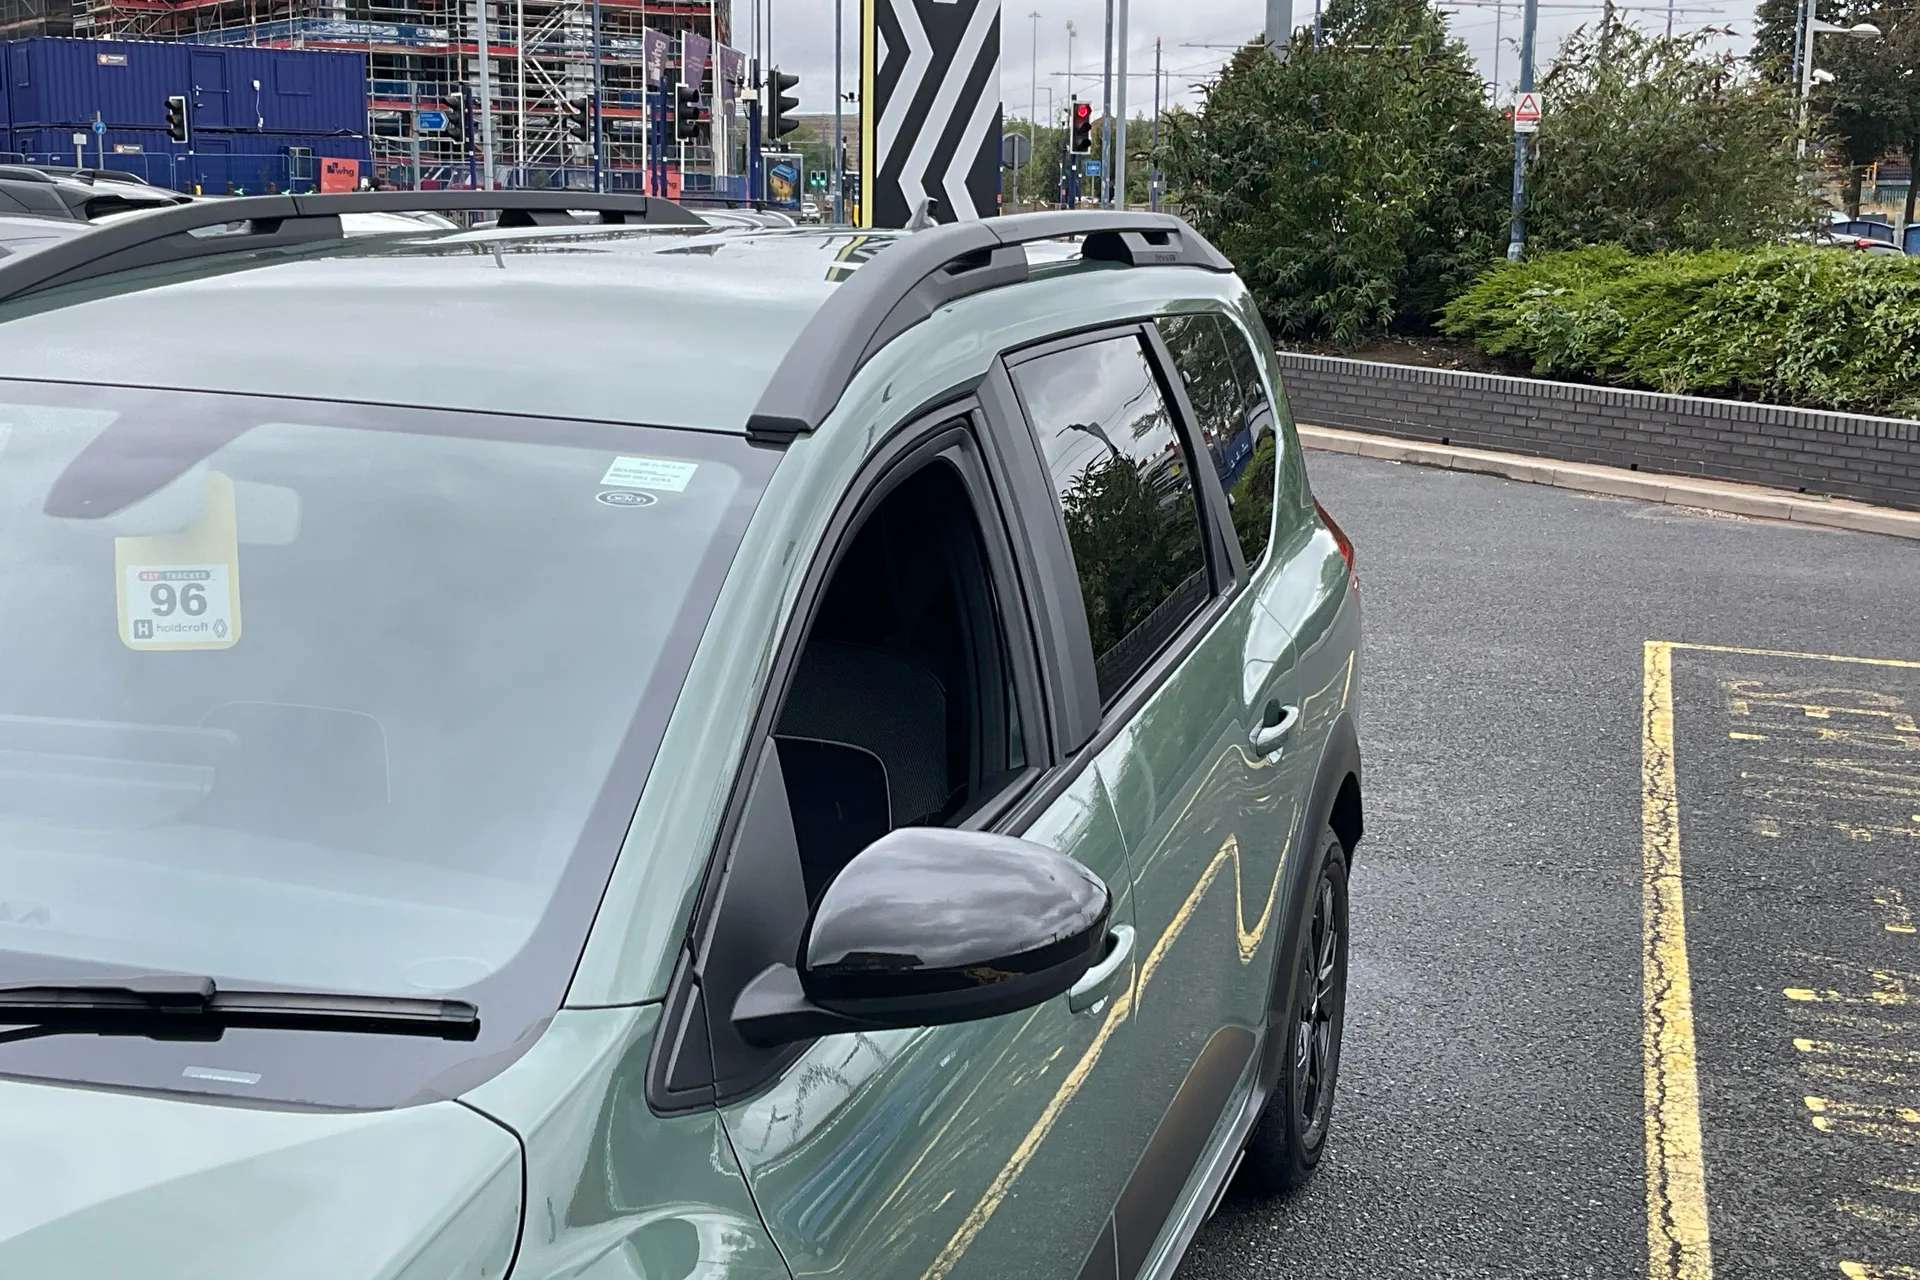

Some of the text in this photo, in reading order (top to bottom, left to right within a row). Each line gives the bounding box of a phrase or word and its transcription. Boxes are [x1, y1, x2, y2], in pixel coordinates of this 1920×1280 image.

[651, 40, 666, 69] whg
[336, 166, 354, 177] whg
[151, 583, 207, 616] 96
[156, 622, 208, 632] holdcroft
